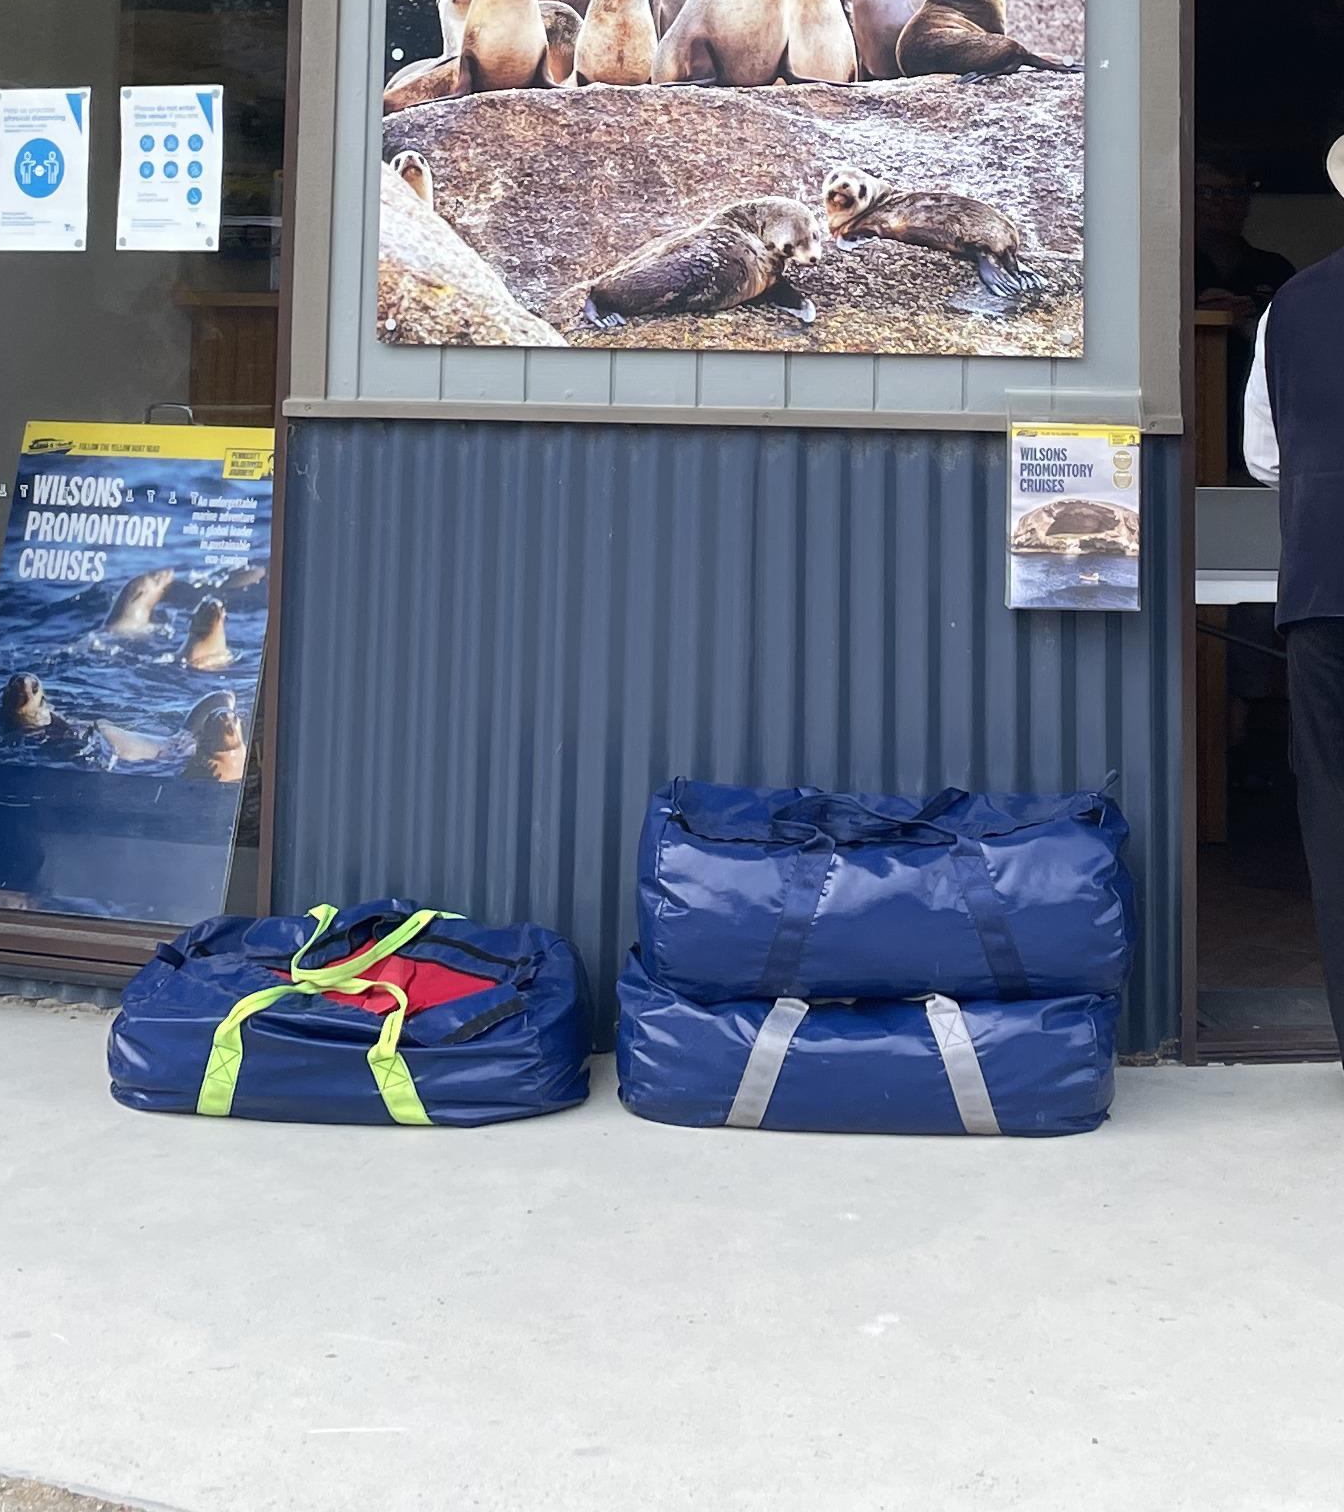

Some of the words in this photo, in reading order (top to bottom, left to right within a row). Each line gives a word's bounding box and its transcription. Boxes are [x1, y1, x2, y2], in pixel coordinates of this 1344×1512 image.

[1019, 447, 1068, 462] WILSONS
[1019, 463, 1094, 478] PROMONTORY
[32, 474, 125, 509] WILSONS
[1019, 478, 1065, 493] CRUISES
[23, 510, 172, 548] PROMONTORY
[18, 546, 108, 584] CRUISES
